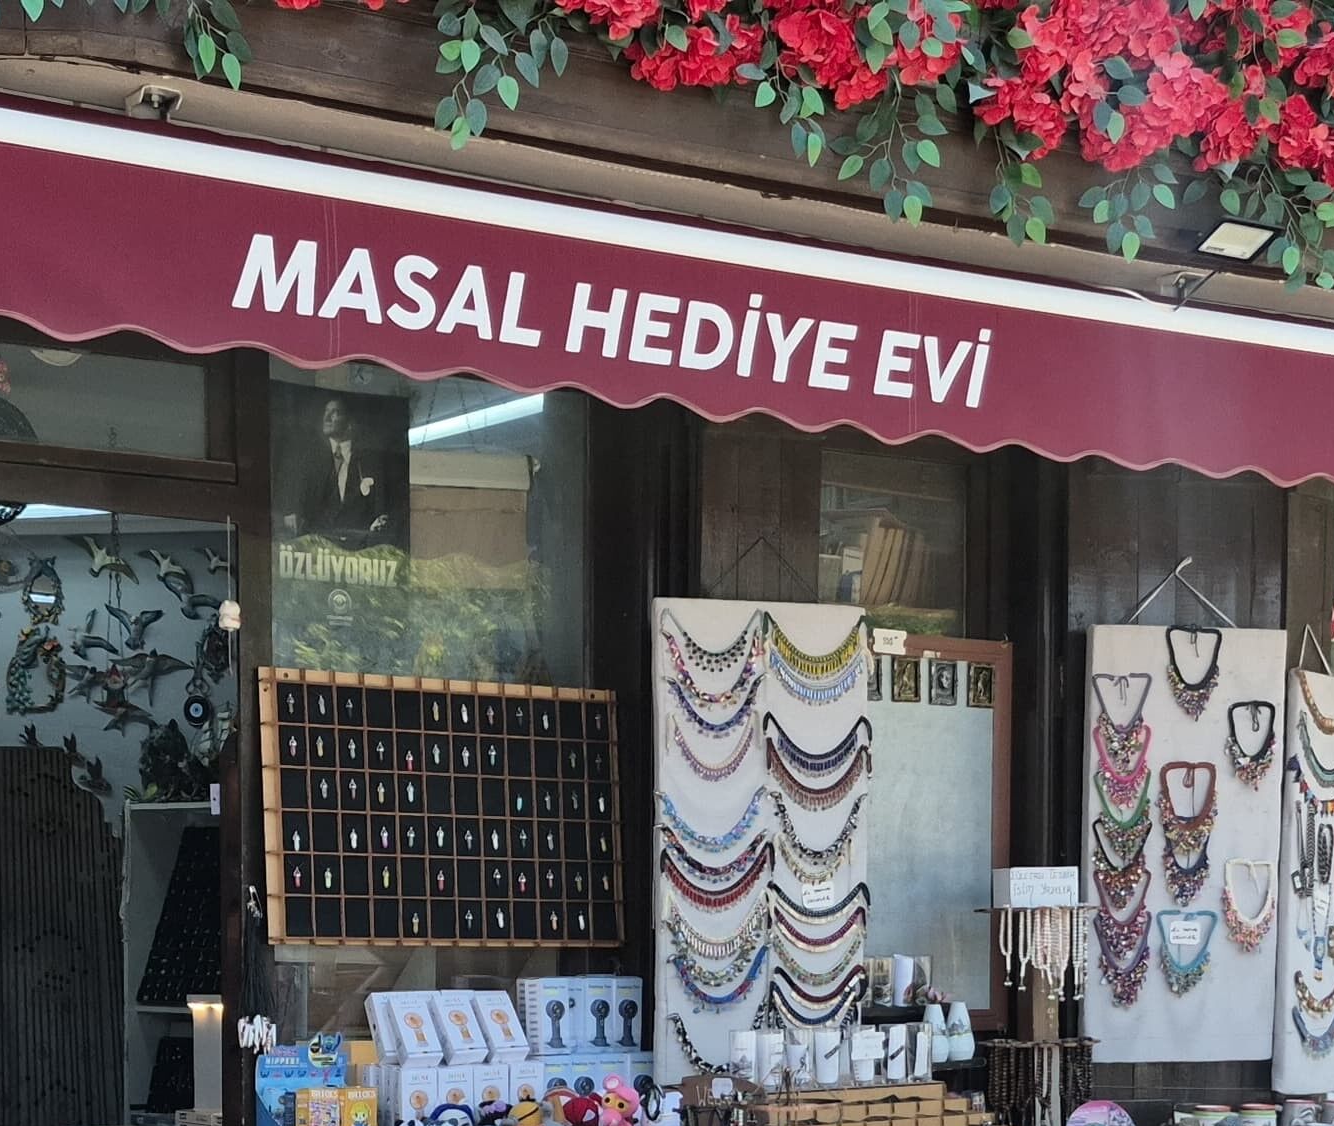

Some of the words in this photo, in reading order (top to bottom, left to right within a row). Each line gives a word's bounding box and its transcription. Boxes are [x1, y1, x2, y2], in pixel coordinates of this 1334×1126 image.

[231, 233, 542, 347] MASAL
[565, 282, 858, 391] HEDİYE
[873, 328, 992, 409] EVİ
[279, 544, 397, 587] ÖZLÜYORUZ
